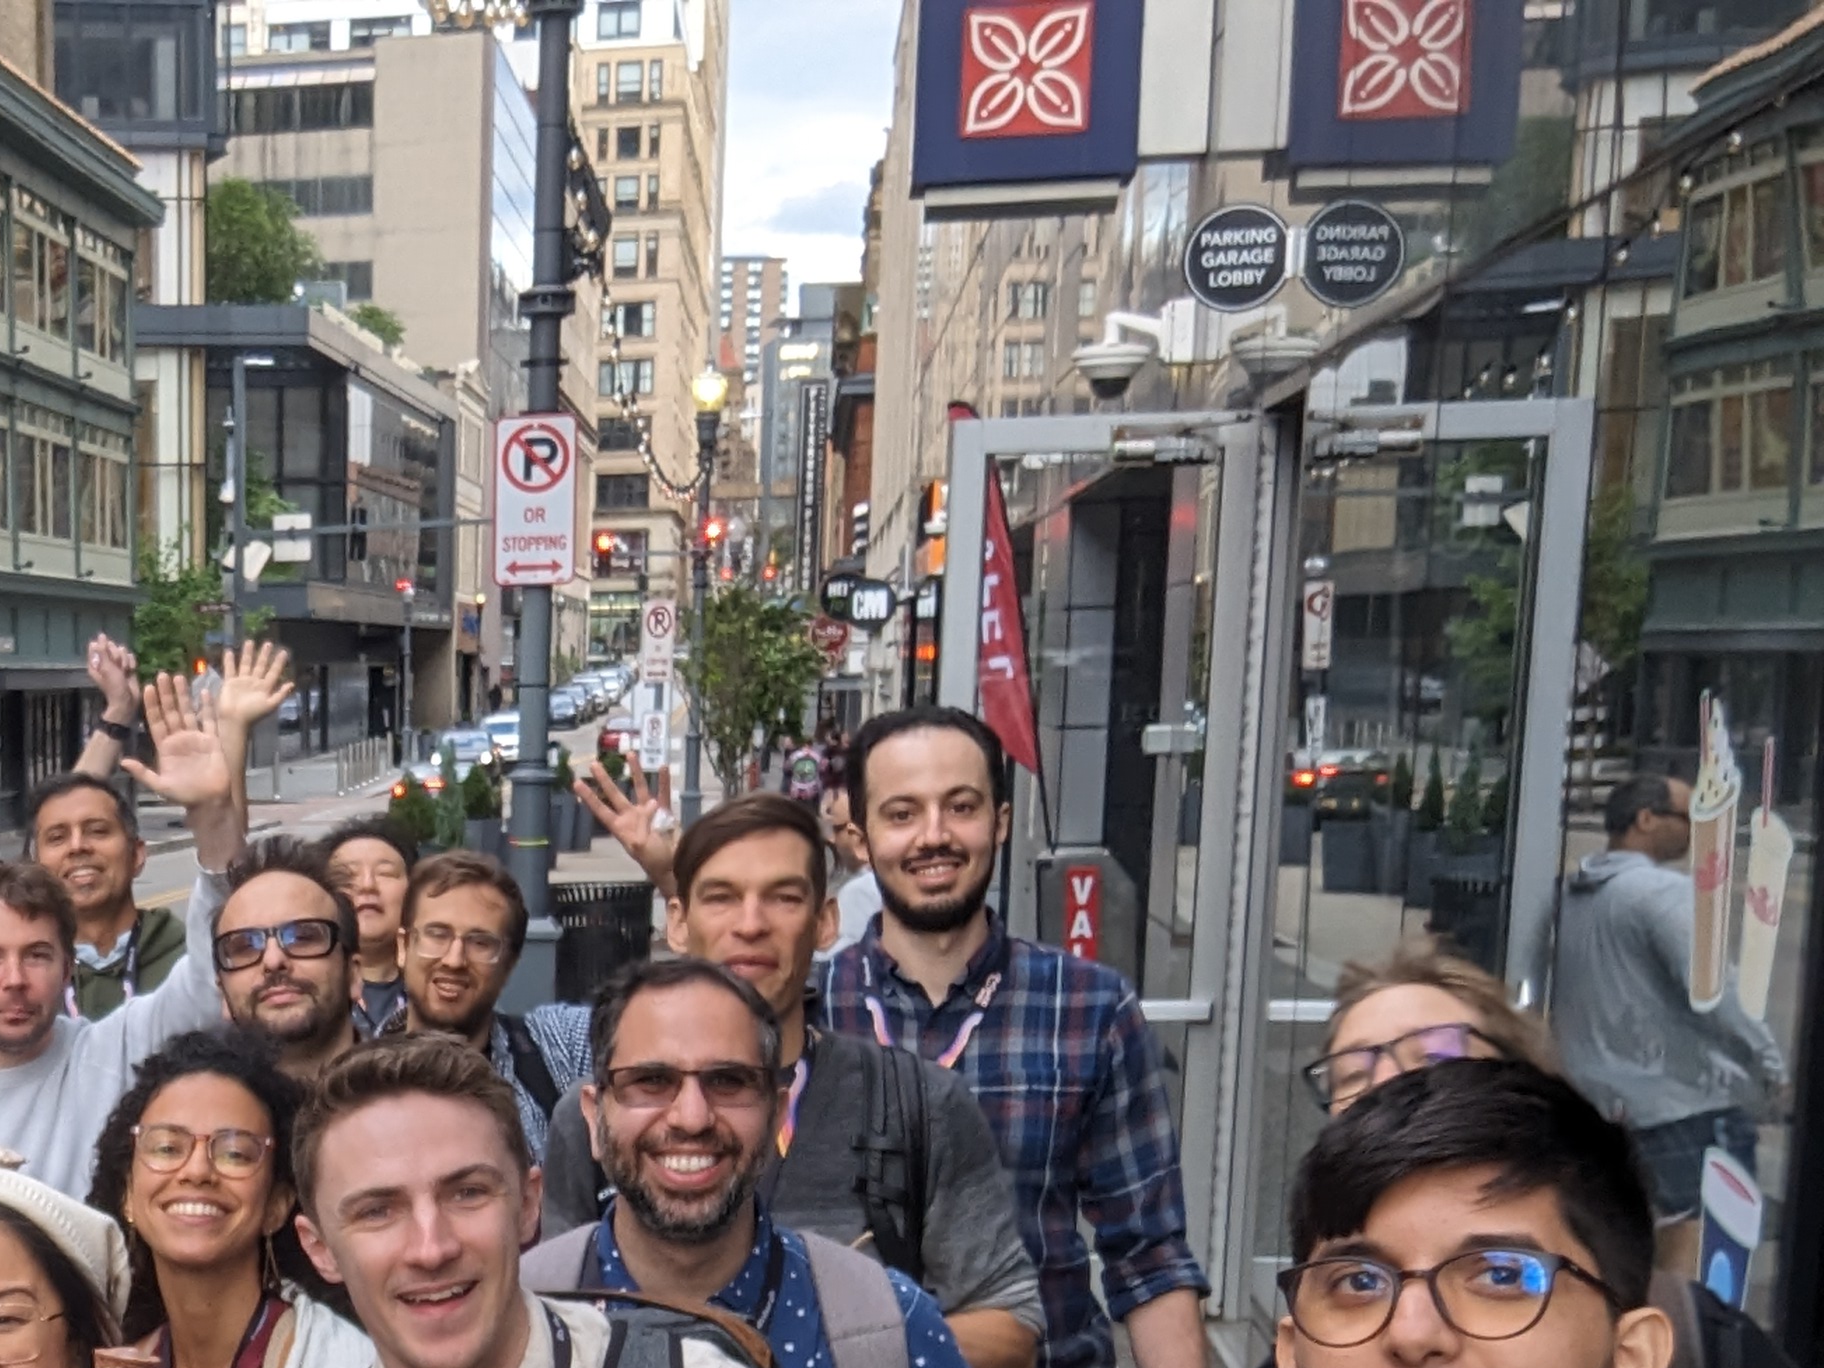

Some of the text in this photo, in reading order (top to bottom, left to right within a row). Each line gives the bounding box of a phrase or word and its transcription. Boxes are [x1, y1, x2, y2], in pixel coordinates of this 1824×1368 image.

[1200, 226, 1277, 248] PARKING
[1201, 248, 1275, 269] GARAGE
[1208, 268, 1266, 288] LOBBY
[523, 507, 546, 523] OR
[502, 534, 568, 552] STOPPING
